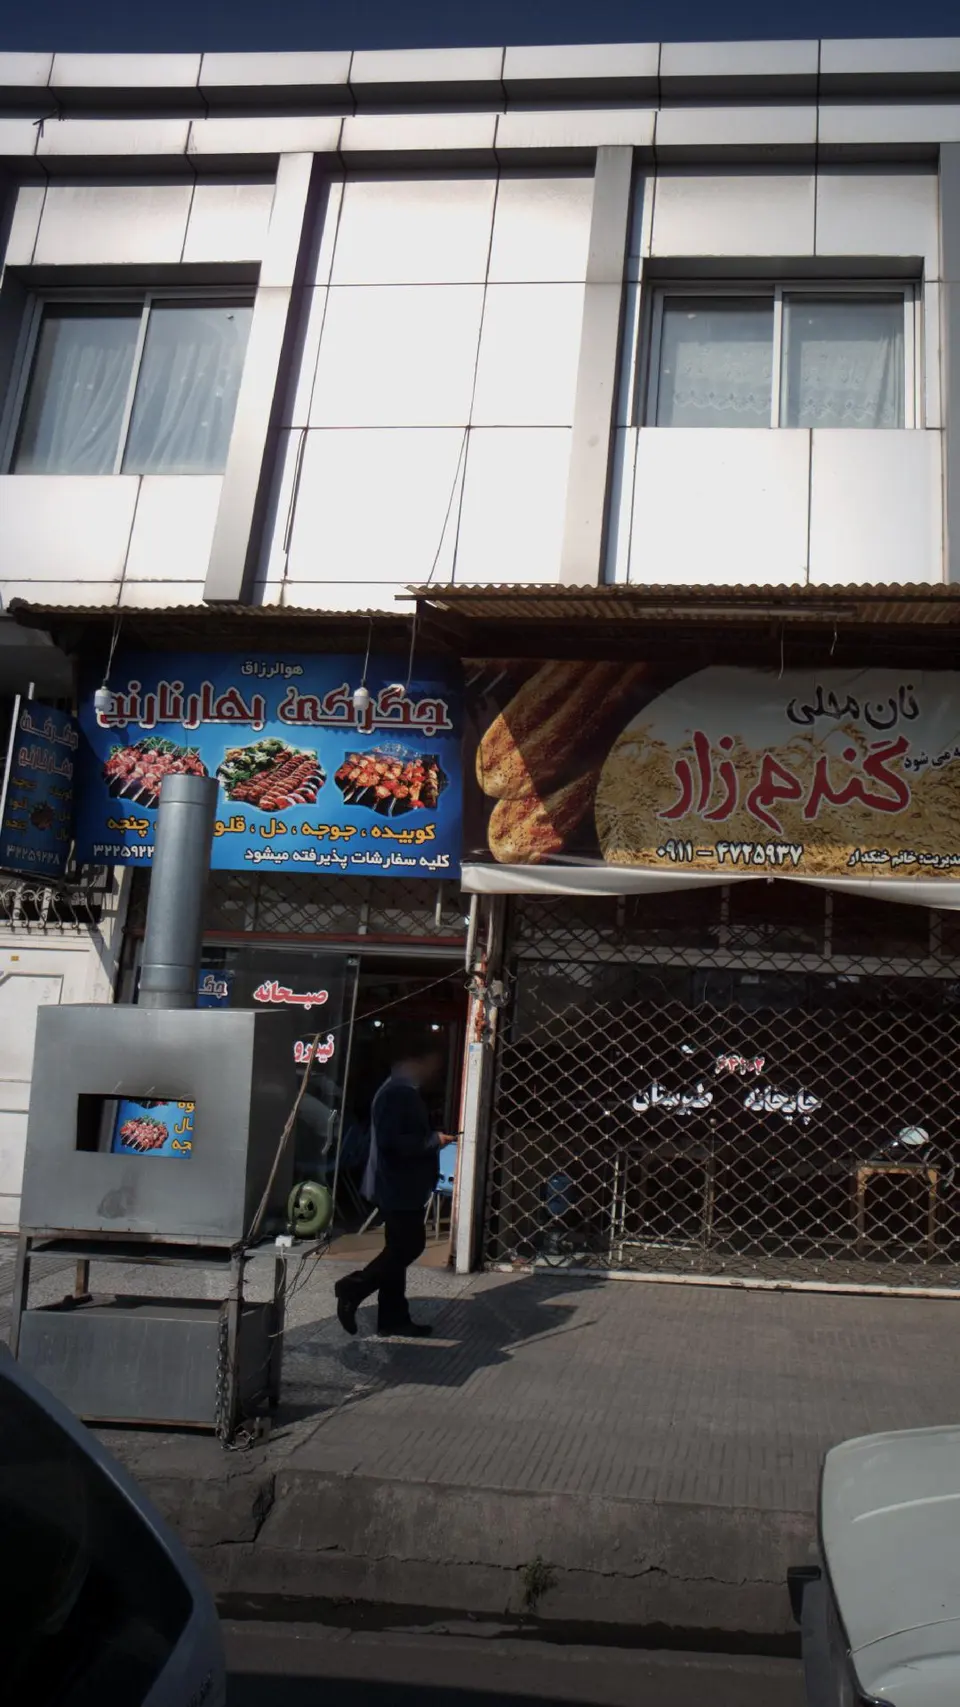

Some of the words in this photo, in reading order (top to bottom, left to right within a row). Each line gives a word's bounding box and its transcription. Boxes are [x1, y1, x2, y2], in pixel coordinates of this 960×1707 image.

[241, 661, 304, 679] هوالرزاق
[785, 684, 861, 725] محلی
[864, 684, 920, 730] نان
[213, 815, 247, 837] قلو
[260, 818, 288, 838] دل
[301, 821, 357, 841] جوجه
[371, 823, 436, 845] کوبیده
[244, 846, 289, 864] میشود
[292, 849, 348, 869] پذیرفته
[350, 852, 417, 866] سفارشات
[419, 854, 451, 870] کلیه
[891, 849, 917, 867] خانم
[252, 979, 329, 1010] صبحانه
